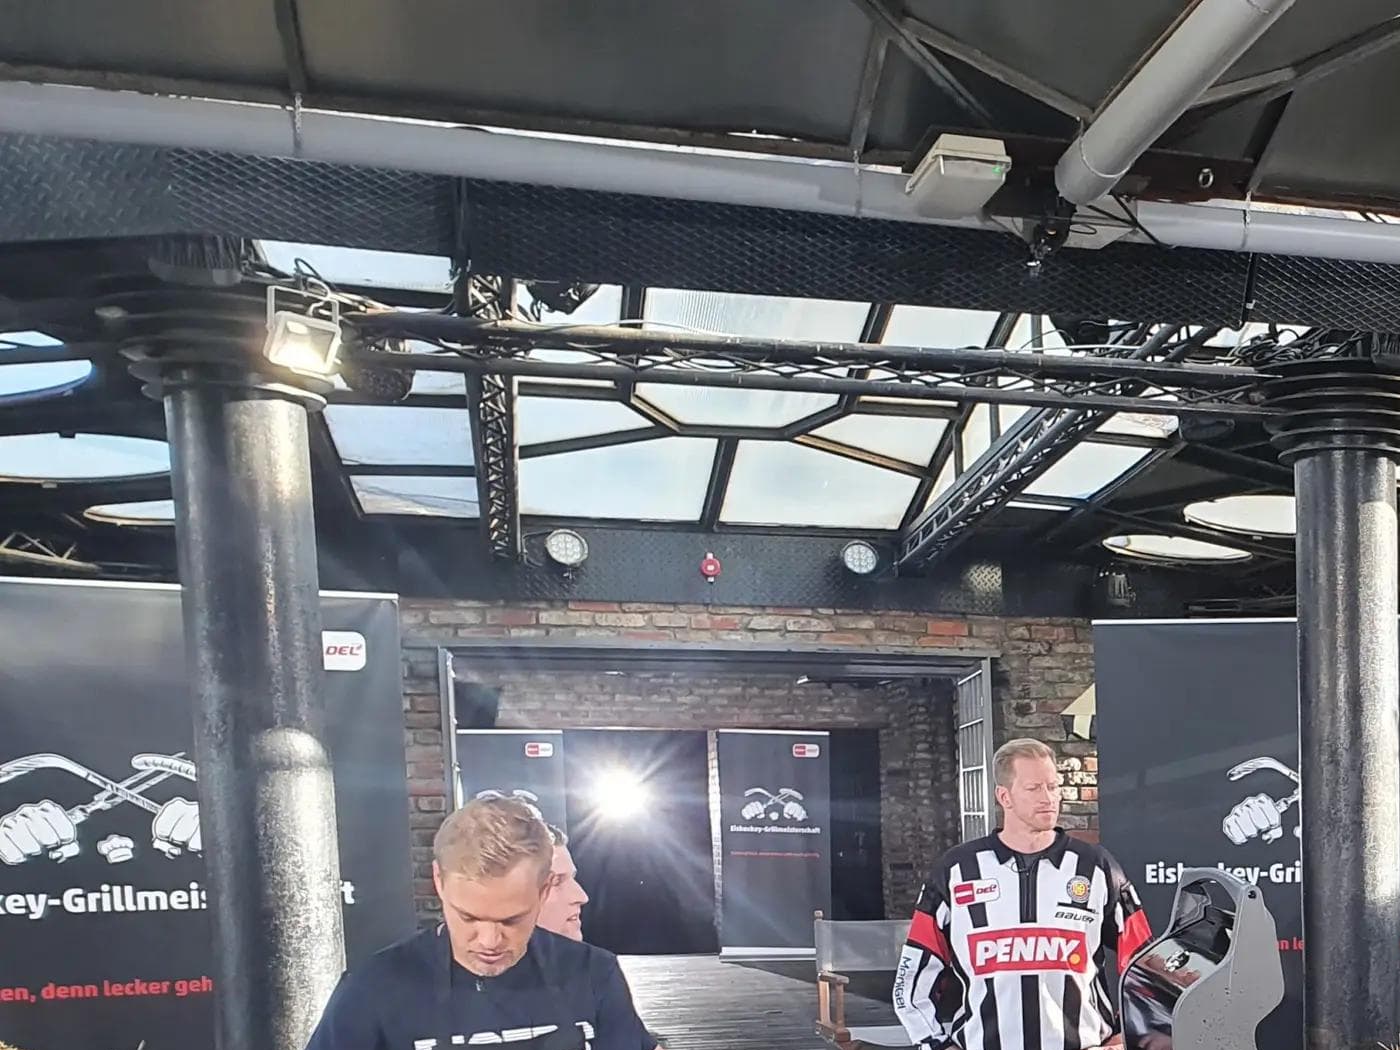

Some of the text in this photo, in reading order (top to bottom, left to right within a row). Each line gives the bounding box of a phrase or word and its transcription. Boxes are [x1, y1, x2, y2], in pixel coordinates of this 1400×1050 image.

[0, 976, 213, 1003] en, denn lecker geh
